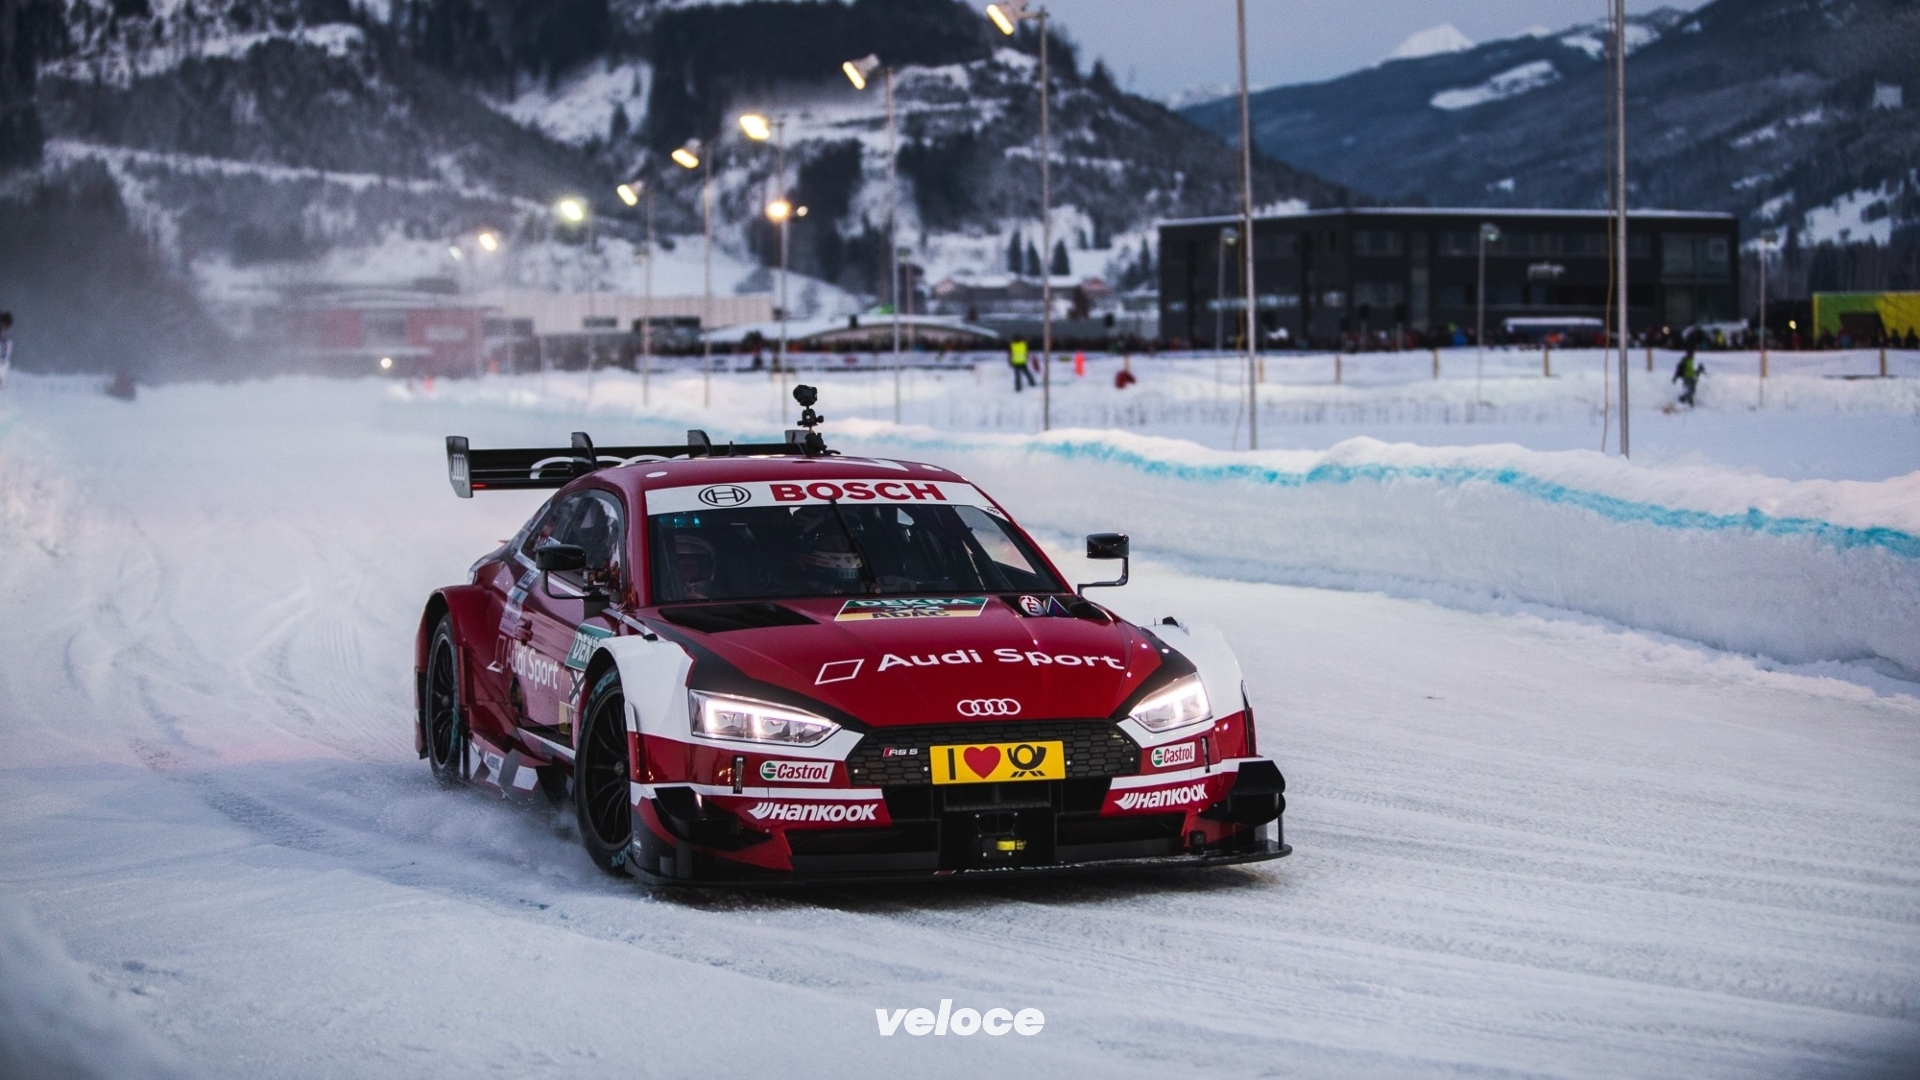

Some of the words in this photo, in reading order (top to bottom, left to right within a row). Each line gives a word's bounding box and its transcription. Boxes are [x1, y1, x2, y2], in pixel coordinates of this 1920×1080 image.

[769, 482, 947, 502] BOSCH
[855, 598, 976, 607] DEKRA
[528, 647, 559, 690] Sport
[877, 650, 983, 671] Audi
[993, 648, 1125, 670] Sport
[947, 748, 956, 780] I
[1163, 745, 1194, 763] Castrol
[777, 763, 828, 780] Castrol
